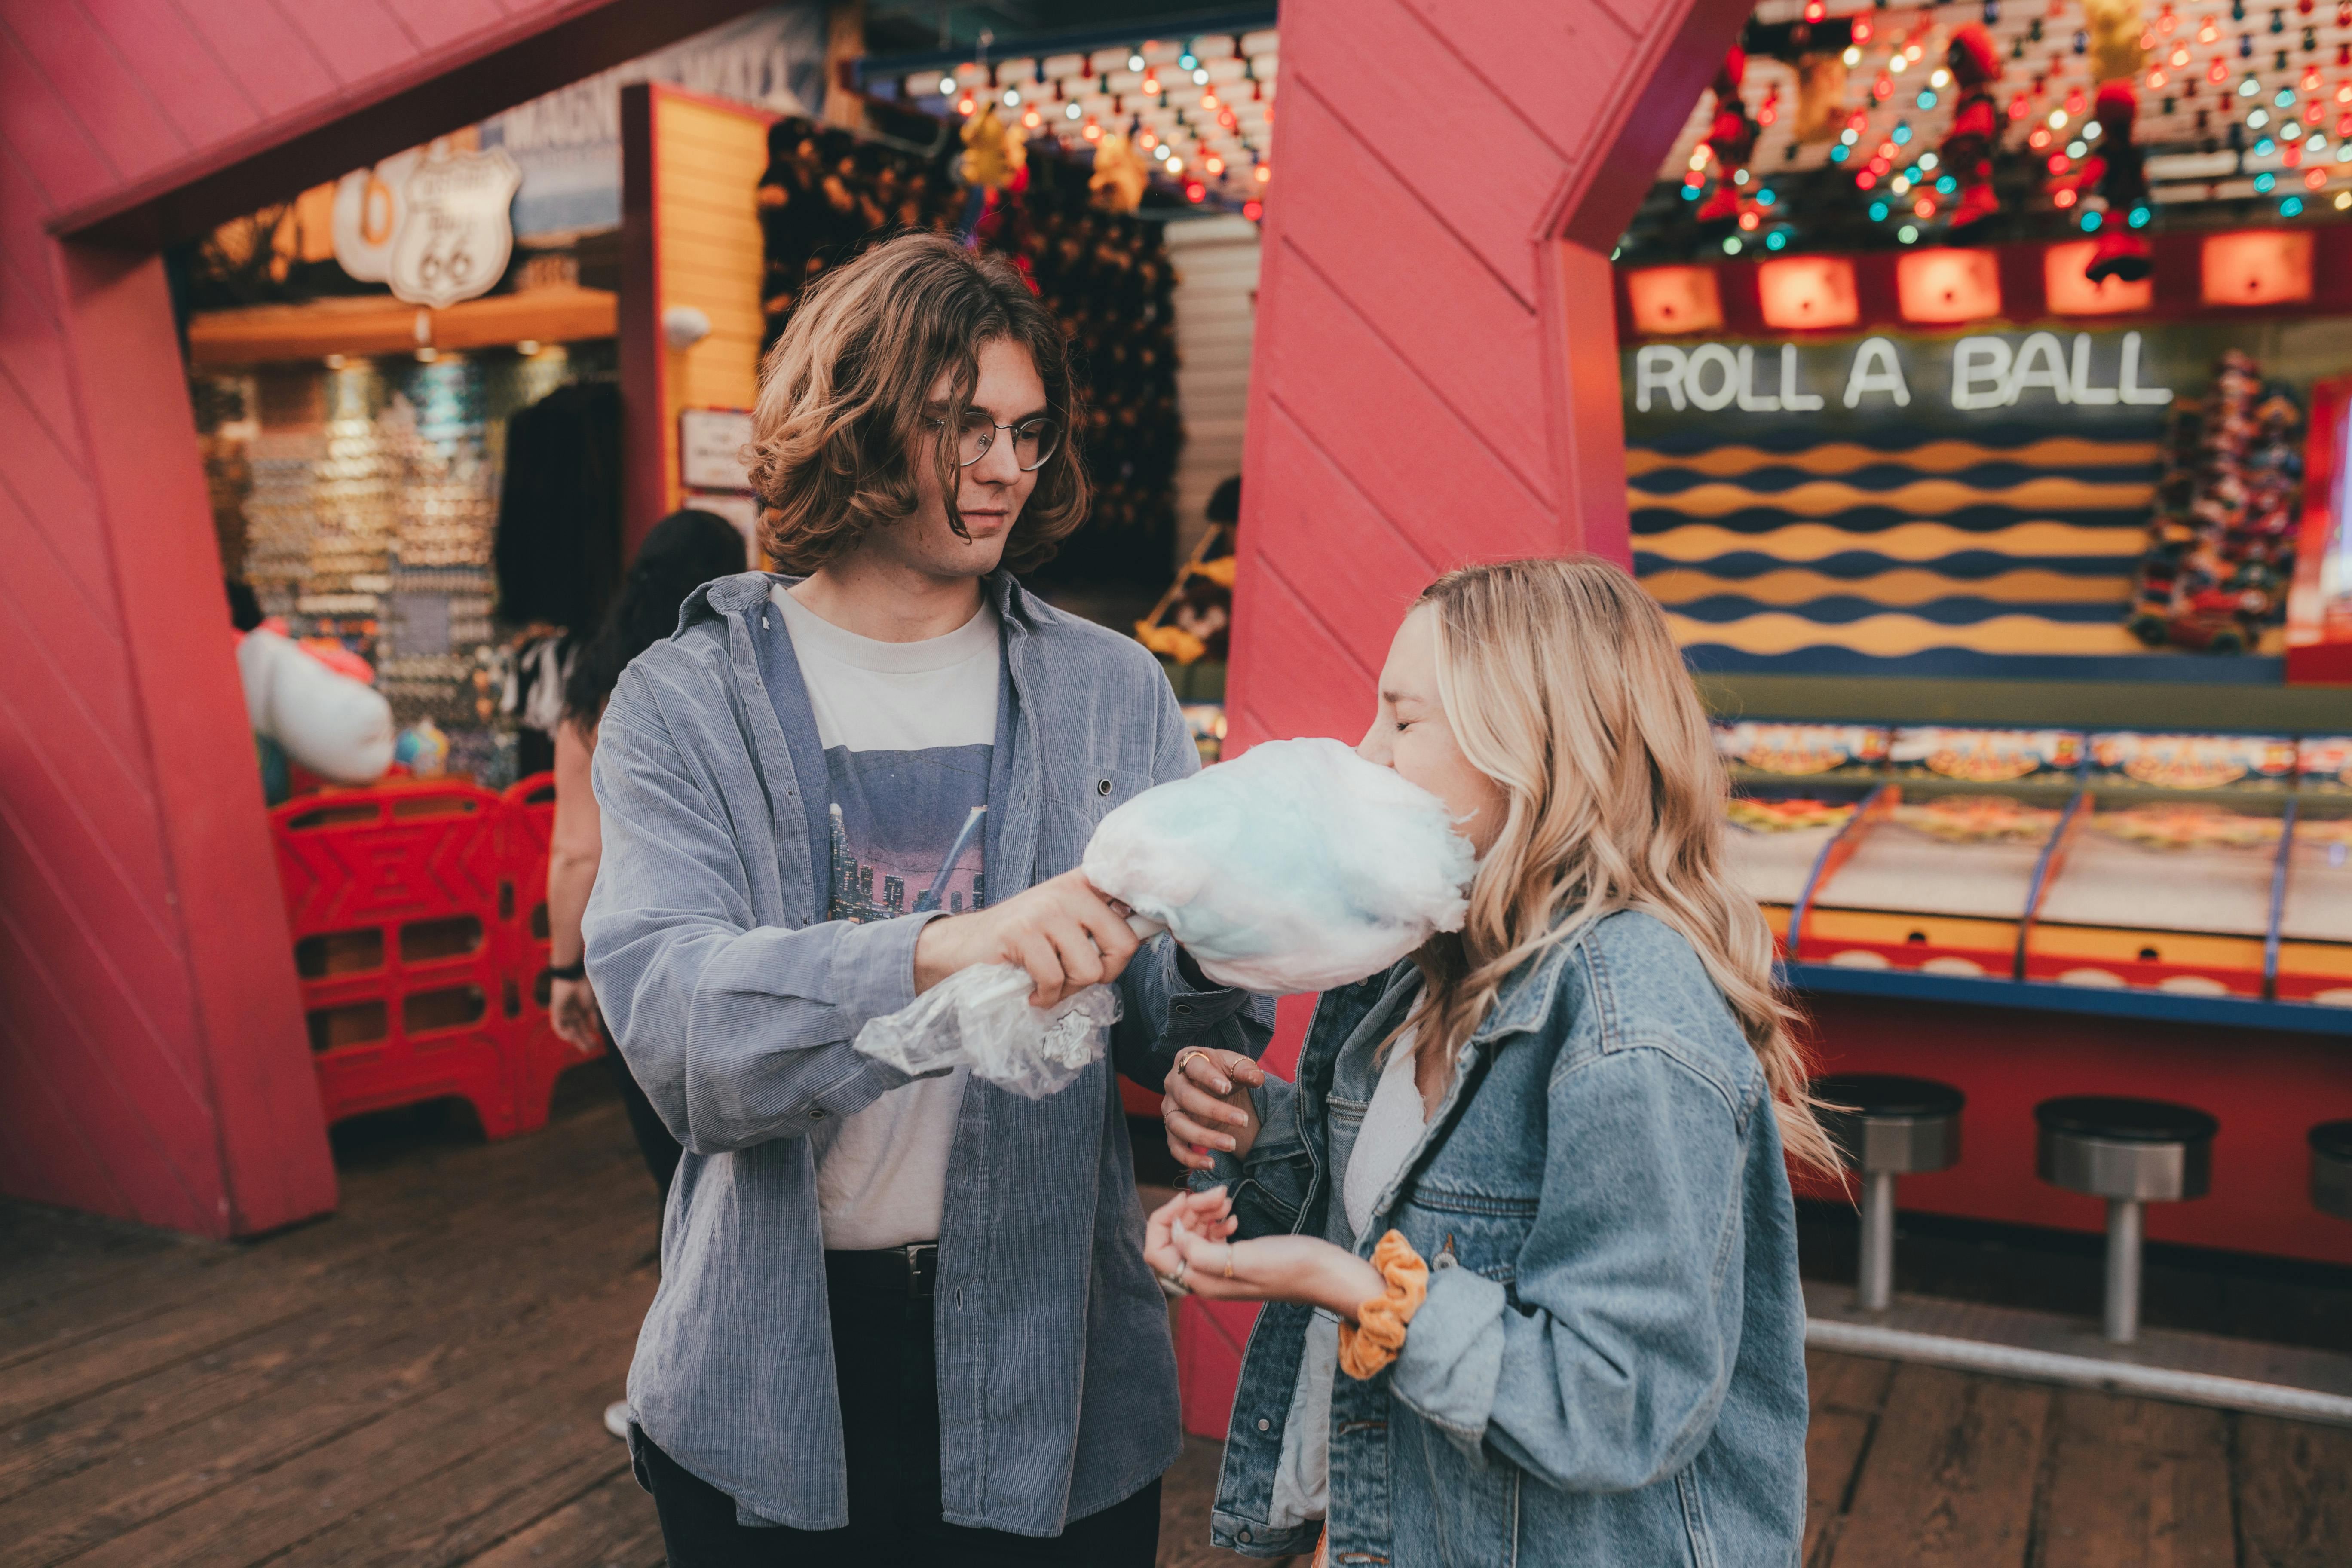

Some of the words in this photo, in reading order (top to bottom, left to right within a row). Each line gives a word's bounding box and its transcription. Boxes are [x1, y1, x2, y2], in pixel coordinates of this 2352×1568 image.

[1636, 342, 1824, 412] ROLL
[1843, 337, 1911, 409] A
[1951, 331, 2174, 410] BALL
